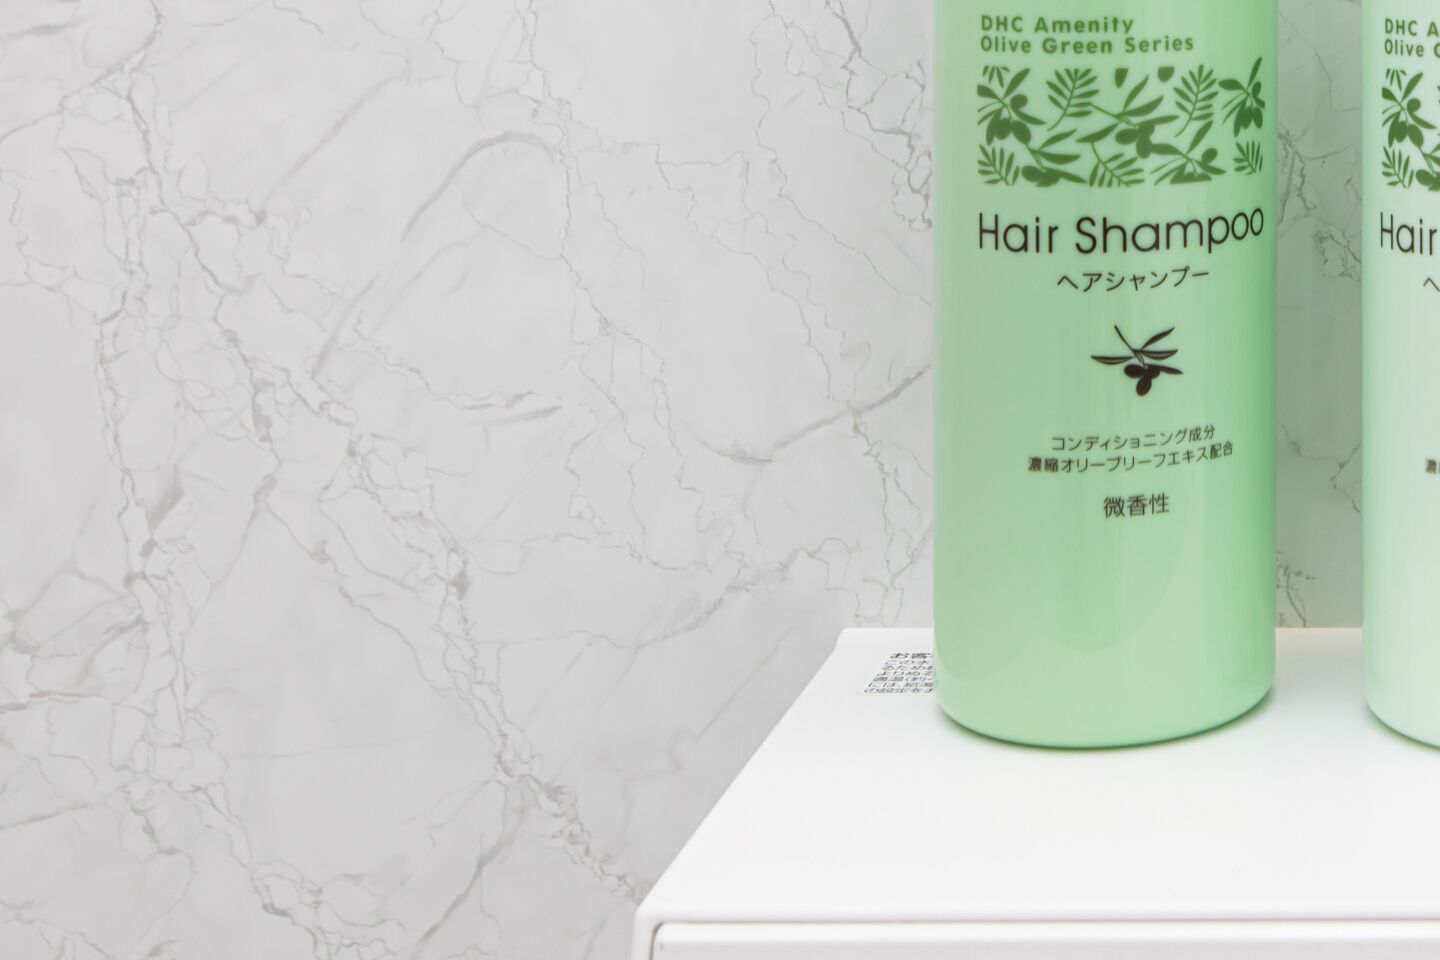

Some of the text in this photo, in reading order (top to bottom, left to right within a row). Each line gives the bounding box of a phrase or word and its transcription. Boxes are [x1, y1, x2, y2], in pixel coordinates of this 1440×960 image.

[980, 14, 1134, 34] DHC Amenity
[1384, 17, 1418, 36] DHC
[980, 35, 1194, 55] Olive Green Series
[1383, 38, 1425, 58] Olive
[979, 207, 1264, 254] Hair Shampoo
[1380, 211, 1438, 256] Hair
[1056, 265, 1210, 293] ヘアシャンプー
[1052, 424, 1216, 451] コンディショニング成分
[1103, 491, 1170, 519] 微香性
